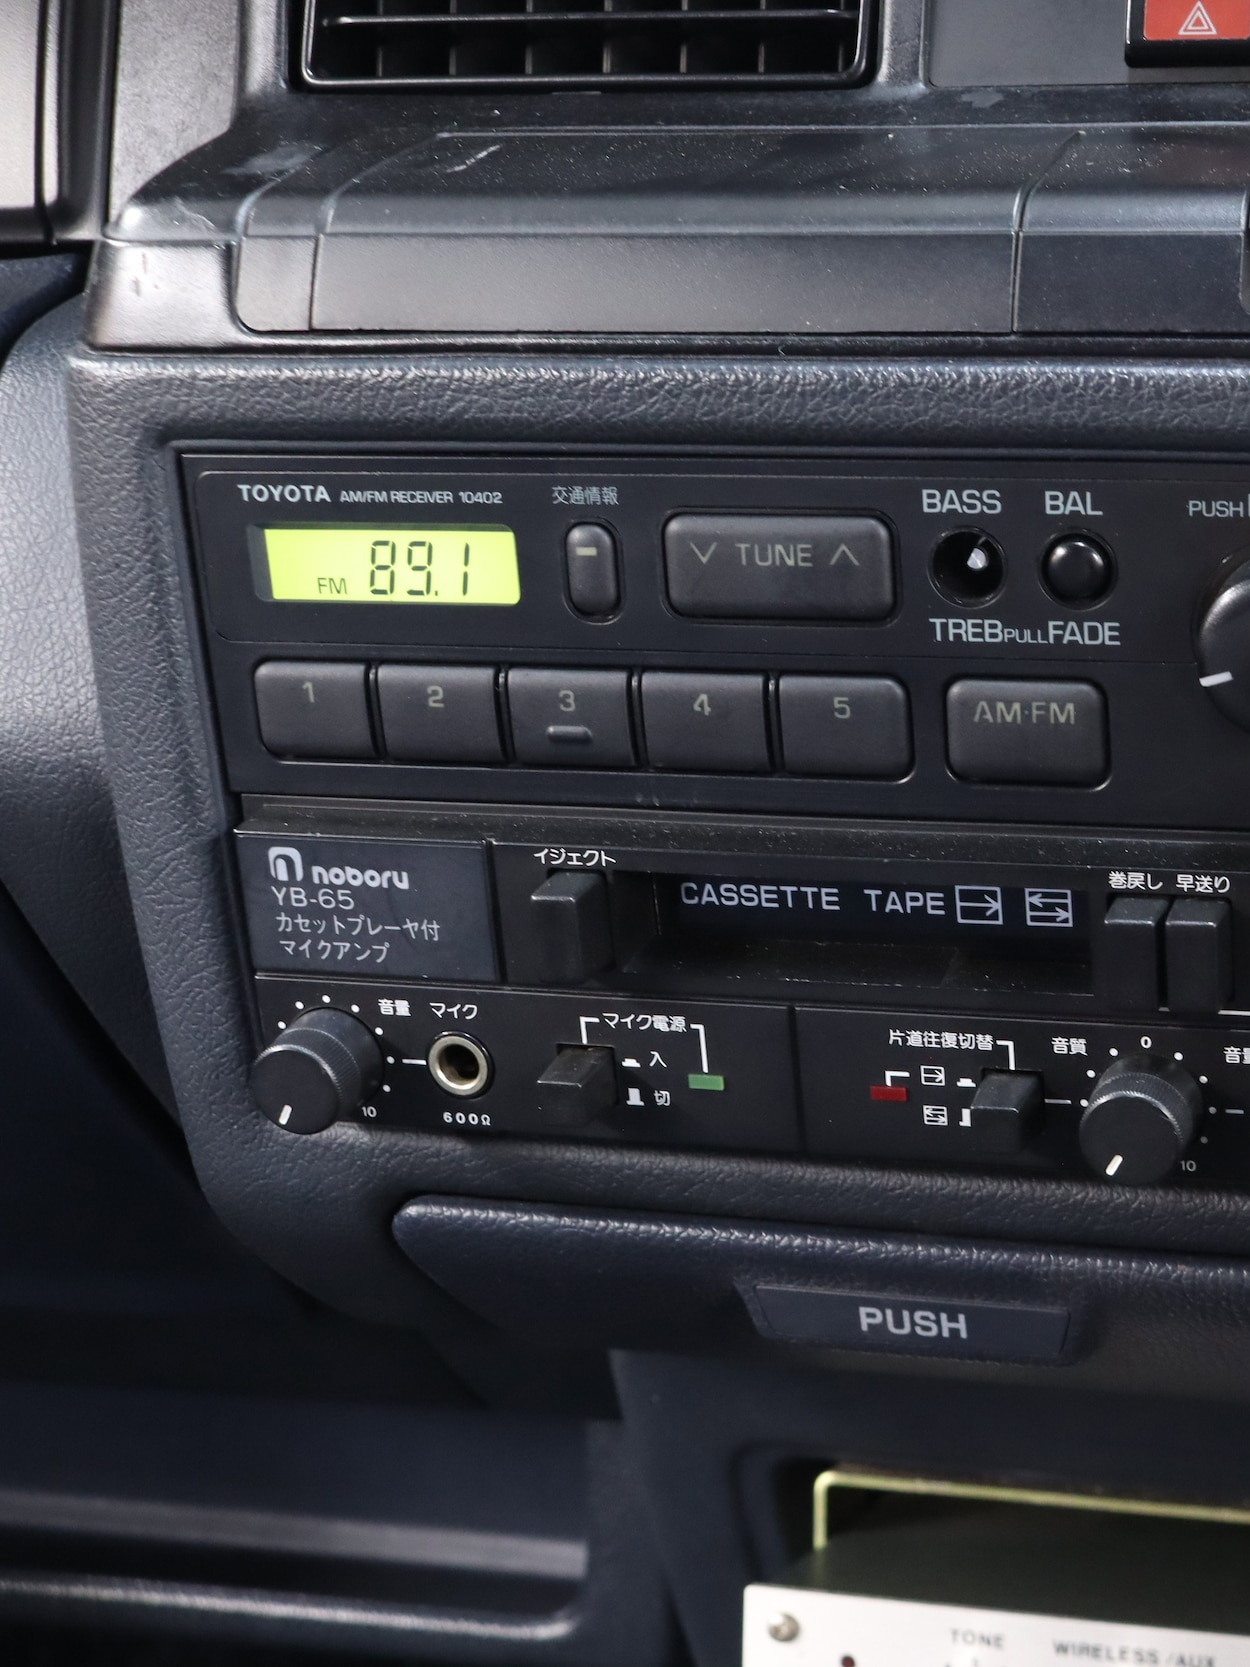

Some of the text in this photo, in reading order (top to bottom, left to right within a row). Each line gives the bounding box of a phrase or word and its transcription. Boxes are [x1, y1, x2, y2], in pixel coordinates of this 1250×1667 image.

[236, 484, 503, 504] TOYOTA AM/FM RECEIVER 10402
[551, 485, 620, 506] 交通情報
[921, 489, 1002, 514] BASS
[1044, 491, 1104, 515] BAL
[1188, 500, 1244, 518] PUSH
[735, 543, 813, 568] TUNE
[317, 540, 471, 596] FM 89.1
[302, 681, 316, 703] 1
[427, 686, 445, 708] 2
[559, 690, 576, 712] 3
[692, 693, 712, 717] 4
[833, 696, 852, 719] 5
[533, 847, 617, 867] イジェクト
[311, 865, 410, 890] noboru
[1108, 871, 1164, 891] 巻戻し
[1175, 873, 1231, 894] 早送り
[270, 885, 355, 910] YB-65
[680, 882, 946, 916] CASSETTE TAPE
[276, 912, 441, 942] カセットプレーヤ付
[279, 939, 391, 963] マイクアンプ
[378, 998, 412, 1019] 音量
[431, 1003, 479, 1021] マイク
[603, 1012, 687, 1034] マイク電源
[888, 1028, 995, 1052] 片道往復切替
[1051, 1036, 1088, 1057] 音質
[649, 1051, 668, 1069] 入
[654, 1090, 672, 1107] 切
[361, 1106, 378, 1119] 10
[1180, 1160, 1197, 1173] 10
[858, 1306, 969, 1340] PUSH
[950, 1628, 1006, 1649] TONE
[1053, 1640, 1160, 1666] WIRELESS
